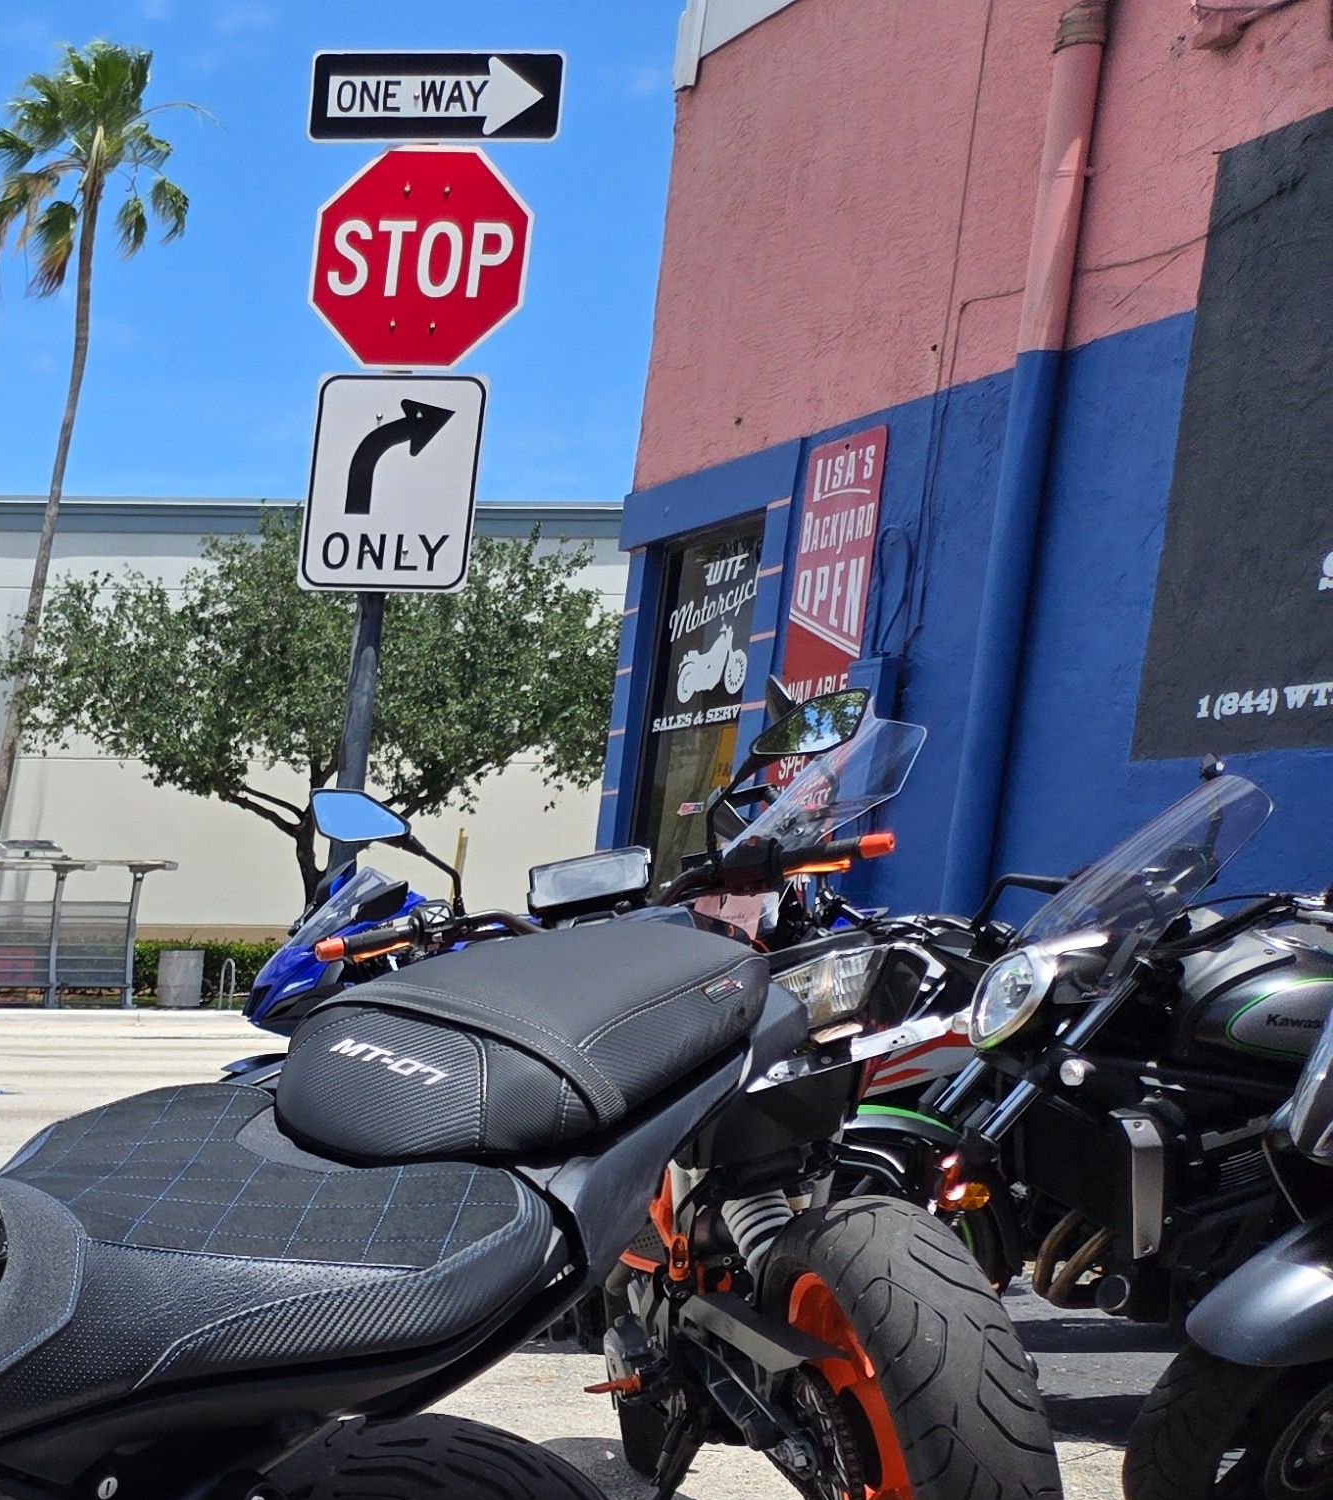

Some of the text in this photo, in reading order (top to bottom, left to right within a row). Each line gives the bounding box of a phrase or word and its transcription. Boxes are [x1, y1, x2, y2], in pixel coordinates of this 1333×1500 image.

[336, 79, 490, 113] ONE WAY
[326, 218, 515, 299] STOP
[812, 444, 876, 503] LISA'S
[800, 502, 875, 555] BACKYARD
[321, 531, 451, 572] ONLY
[704, 552, 749, 586] WTF
[669, 563, 760, 643] Motorcycl
[796, 556, 865, 638] OPEN
[652, 703, 741, 733] SALES & SERV
[1196, 681, 1333, 721] 1 (844) WT
[1266, 1013, 1324, 1029] Kawas
[328, 1038, 449, 1086] MT-07
